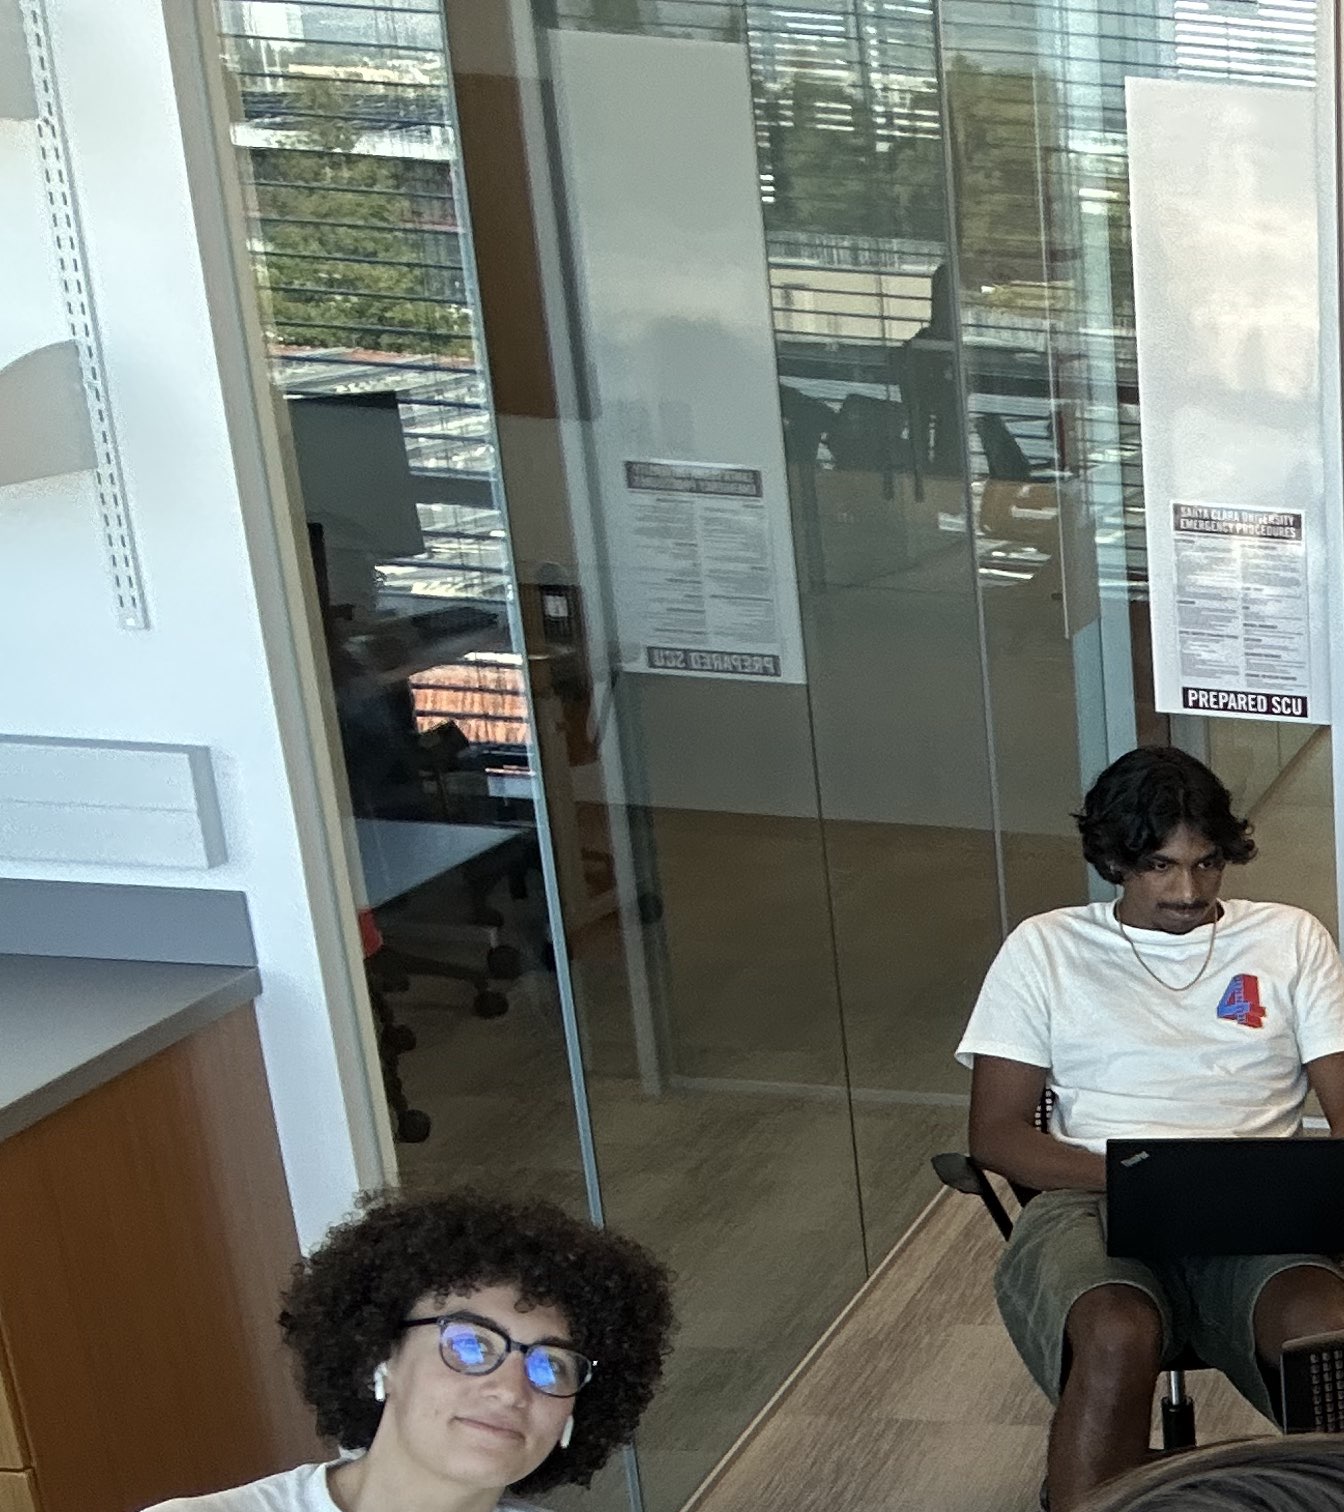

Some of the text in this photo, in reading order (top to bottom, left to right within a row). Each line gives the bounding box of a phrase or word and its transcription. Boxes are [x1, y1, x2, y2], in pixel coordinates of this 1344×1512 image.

[1180, 506, 1294, 527] SANTA CLARA UNIVERSITY
[1180, 518, 1297, 539] EMERGENCY PROCEDURES
[1187, 688, 1303, 716] PREPARED SCU
